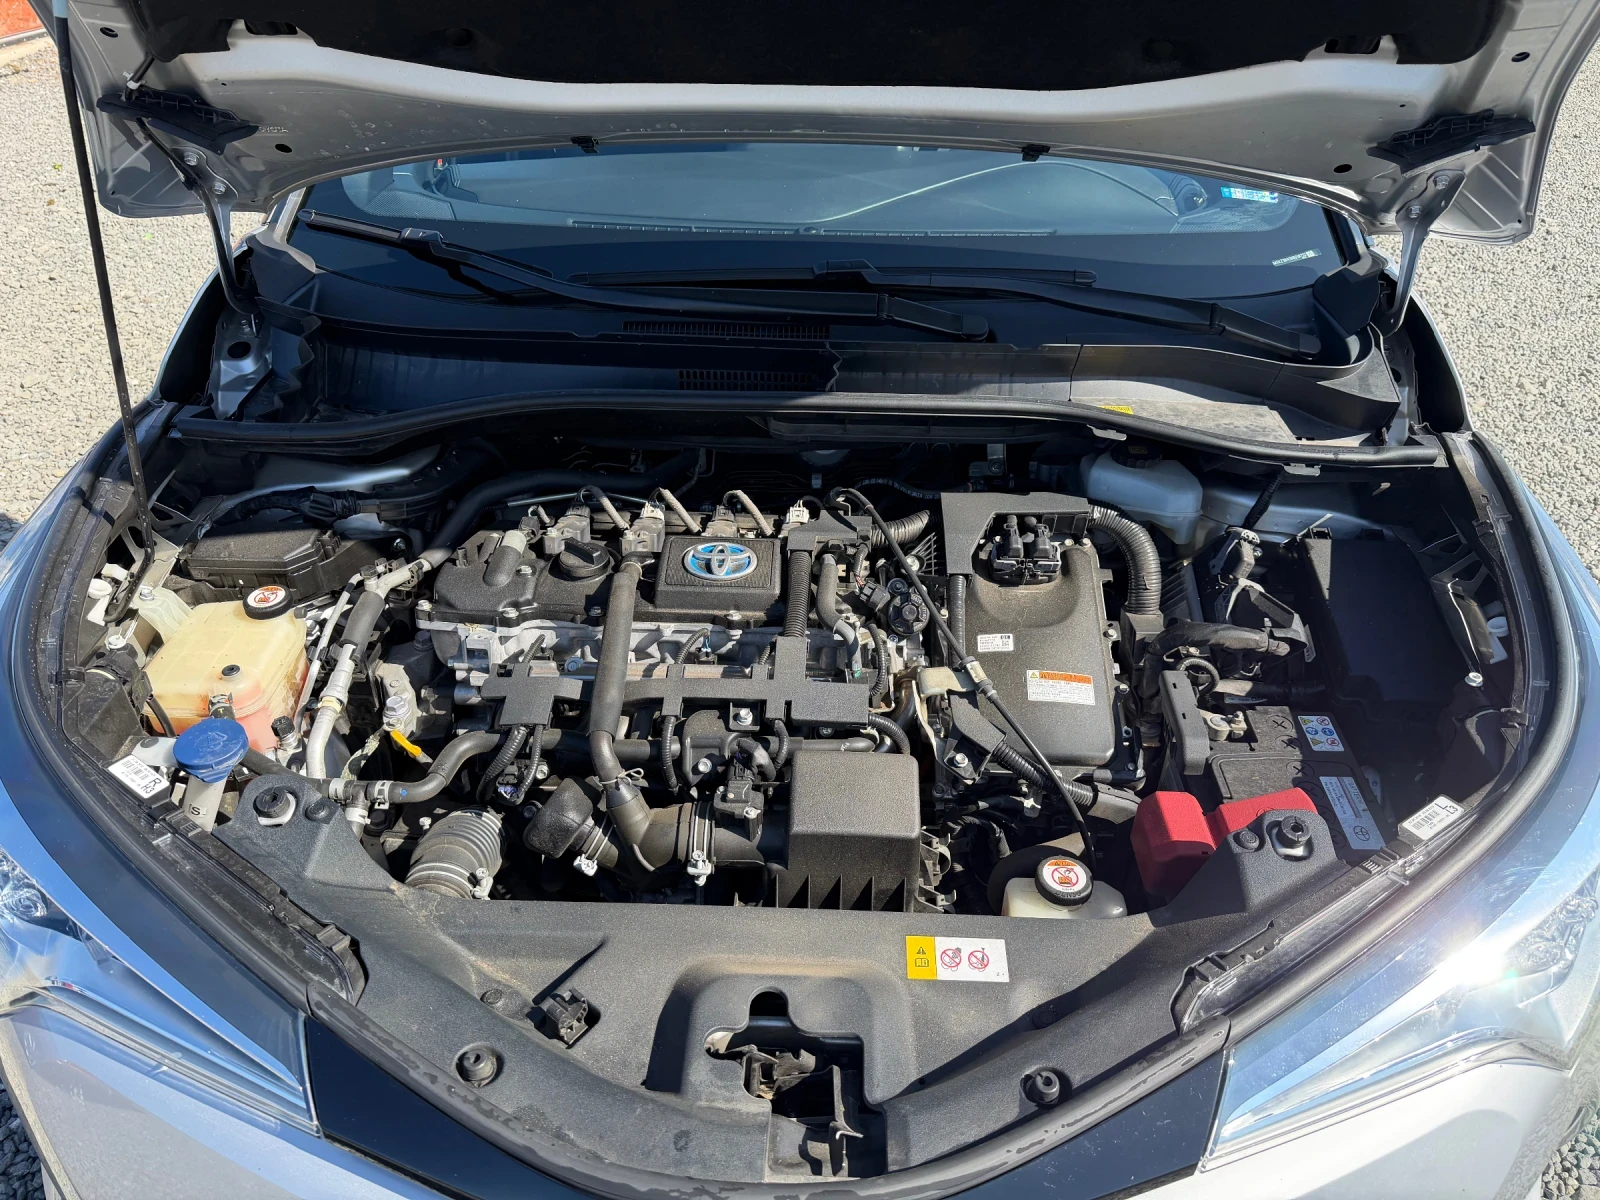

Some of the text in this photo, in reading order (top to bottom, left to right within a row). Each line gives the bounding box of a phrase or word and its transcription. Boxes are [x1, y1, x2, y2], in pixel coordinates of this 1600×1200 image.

[150, 777, 162, 788] R
[140, 785, 155, 794] H3
[1434, 802, 1449, 810] L
[1444, 805, 1459, 815] L3
